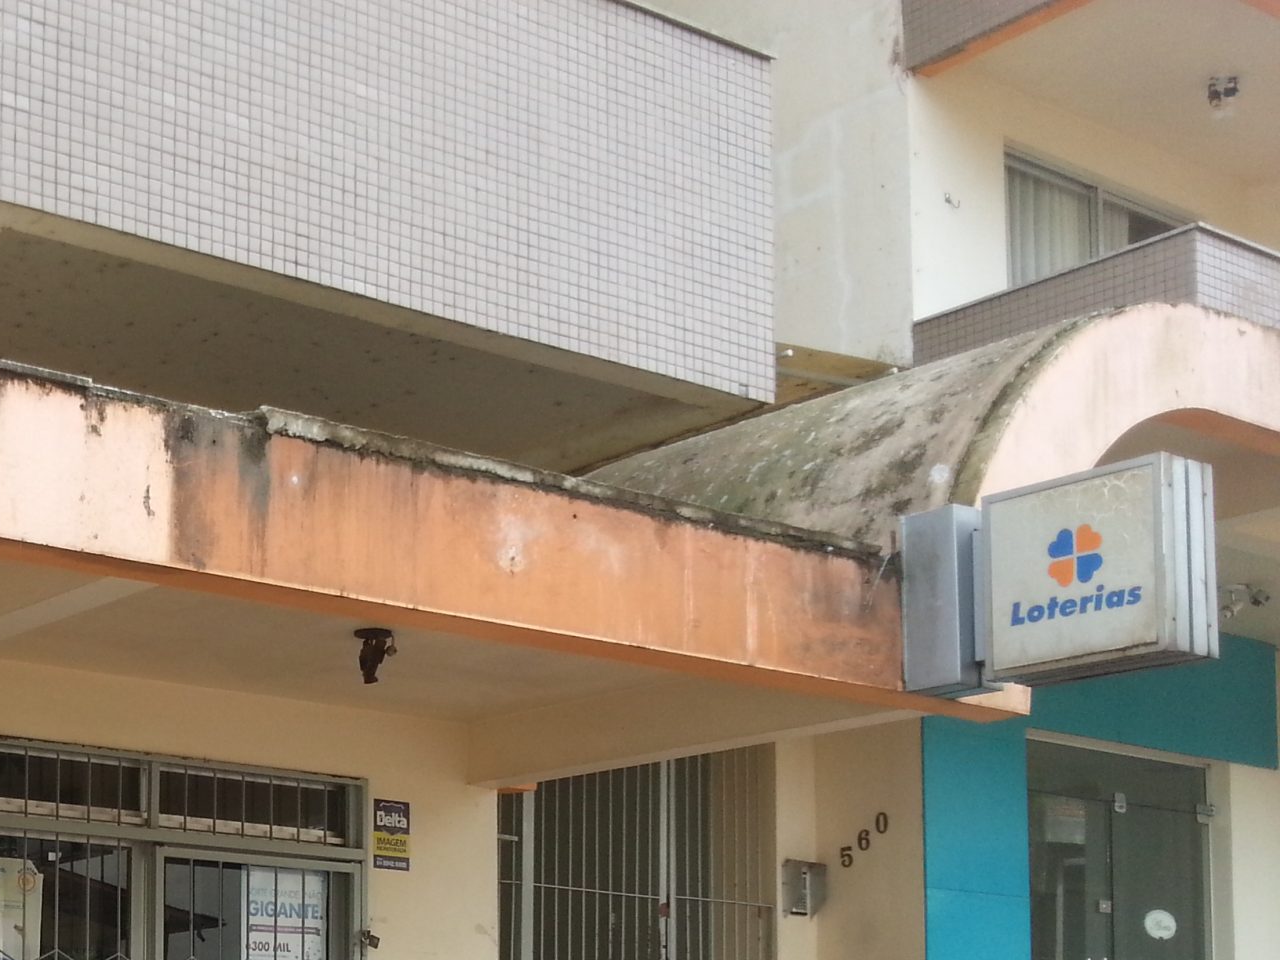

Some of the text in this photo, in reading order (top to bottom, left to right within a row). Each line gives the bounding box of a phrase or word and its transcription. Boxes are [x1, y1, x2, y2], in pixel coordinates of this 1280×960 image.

[1009, 584, 1143, 627] Loterias
[376, 810, 408, 828] Delta
[376, 836, 407, 847] IMAGEM
[840, 812, 888, 868] 560
